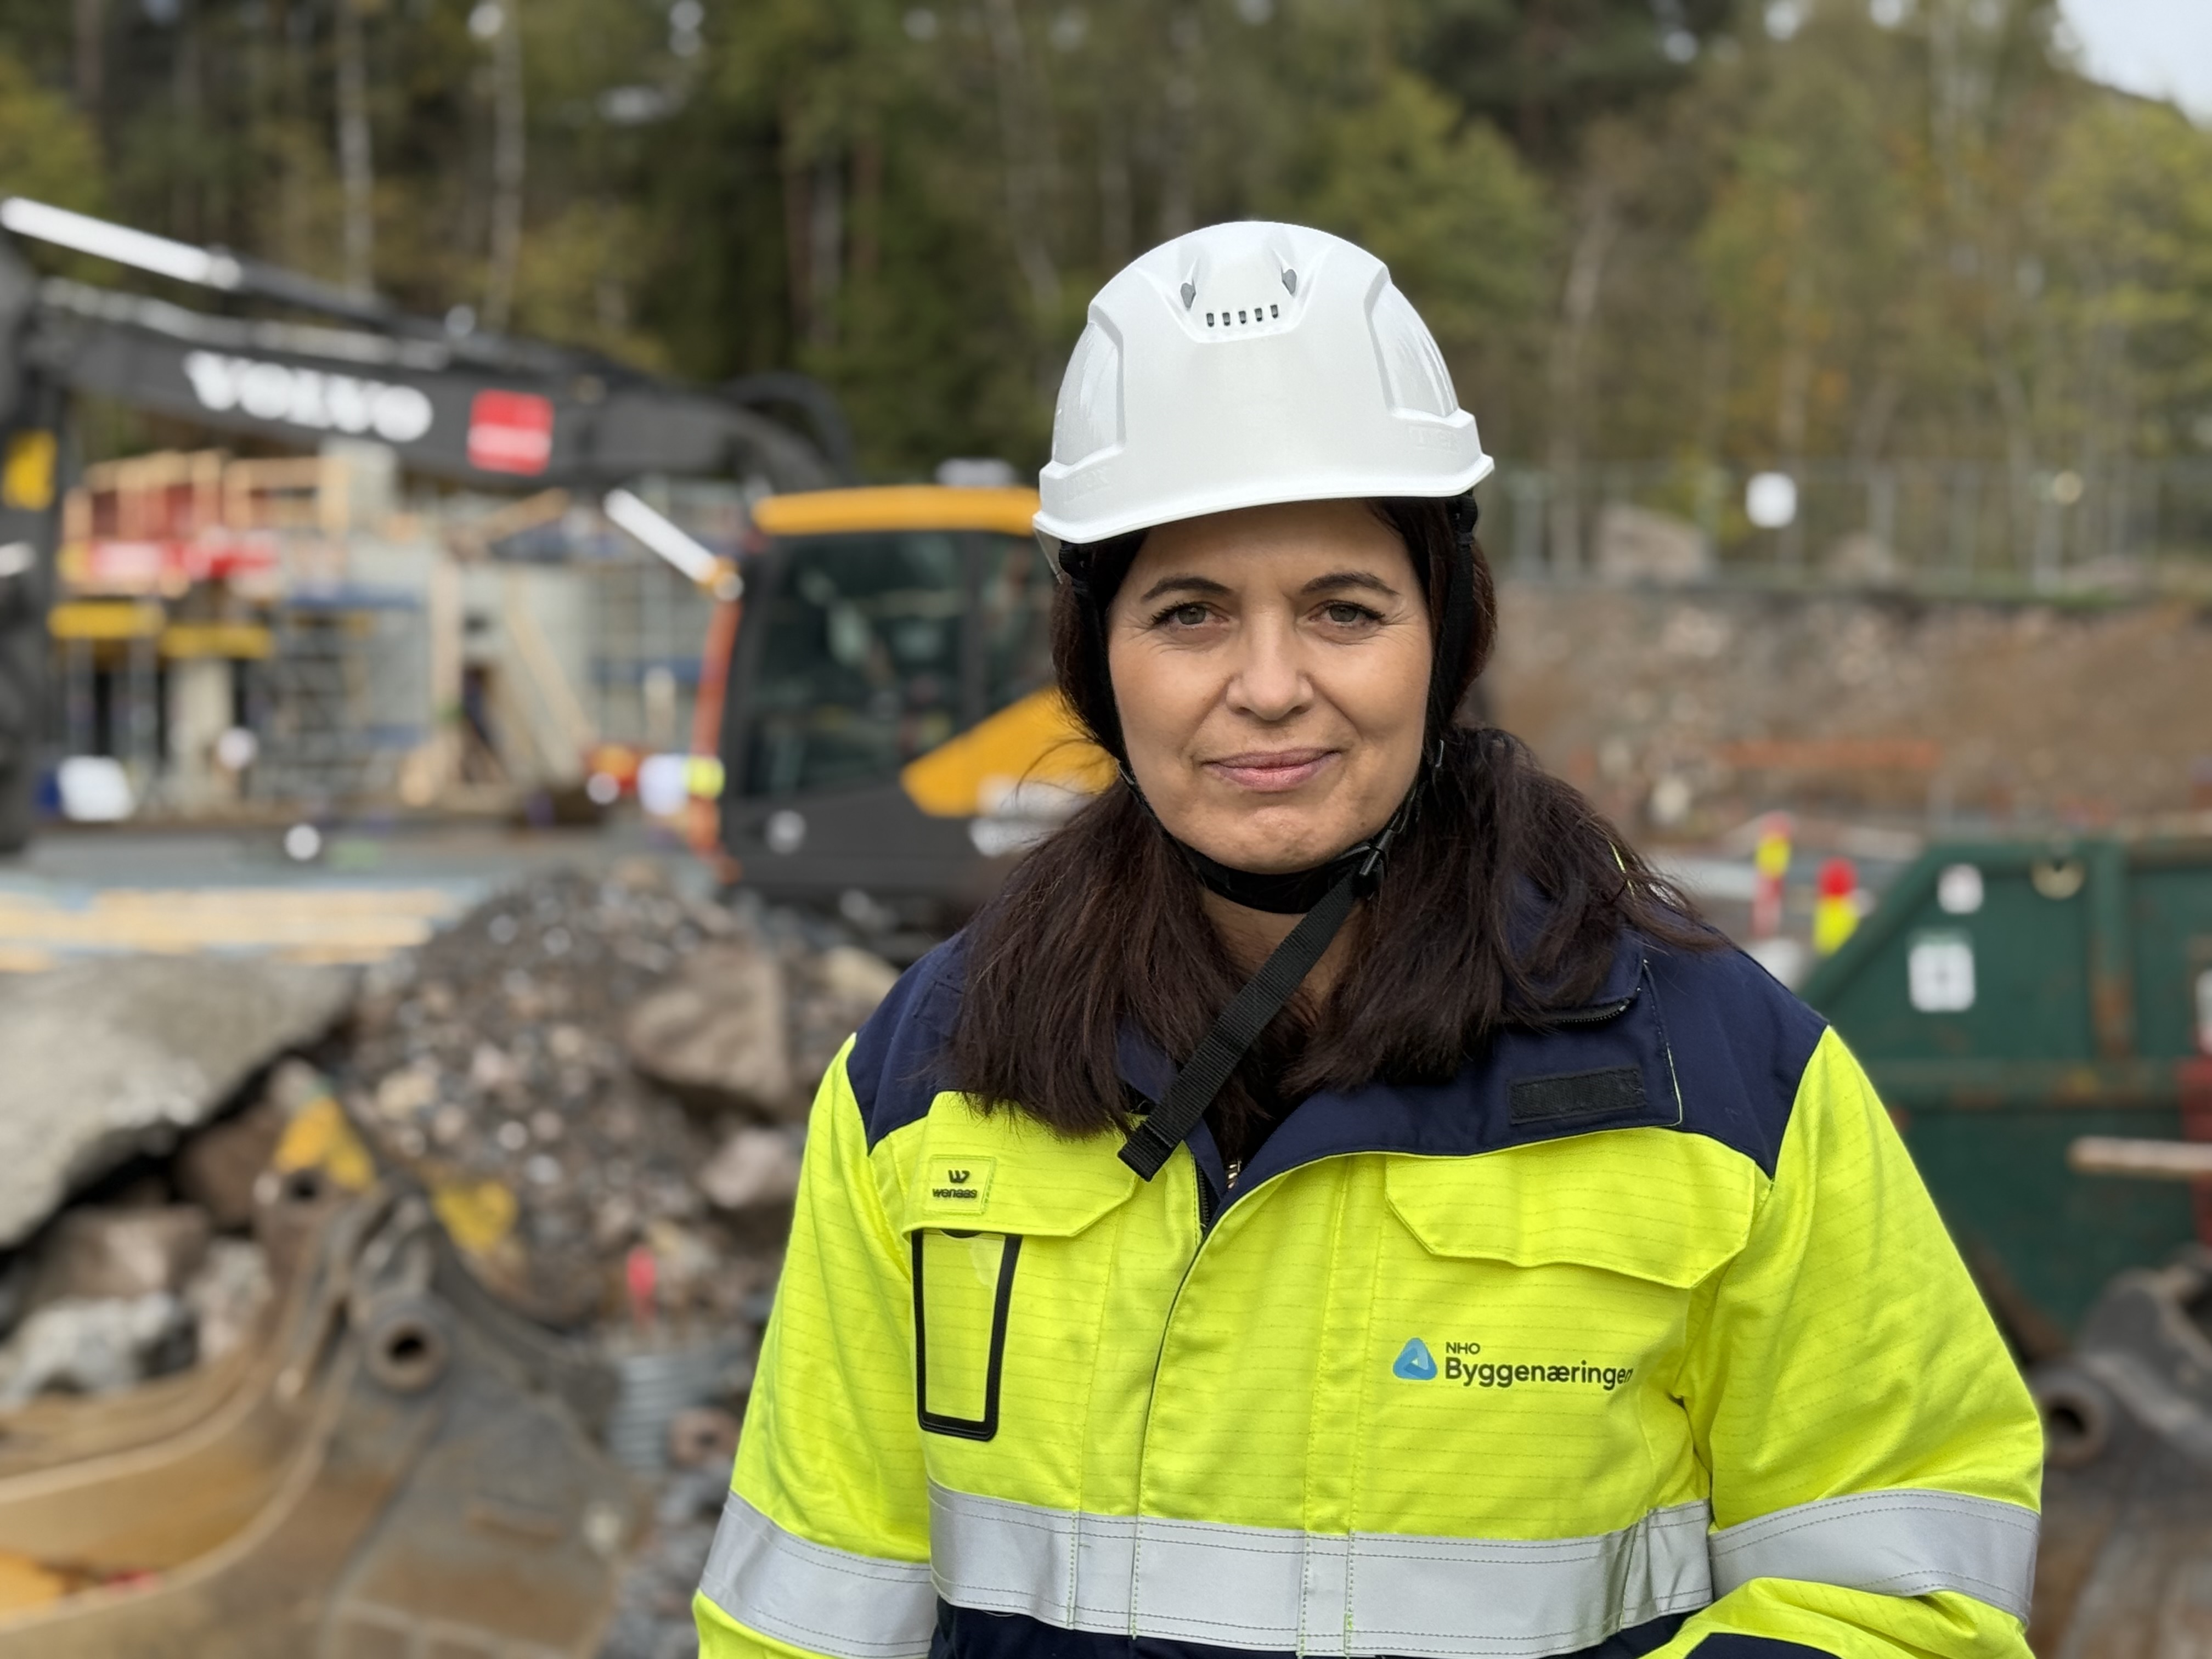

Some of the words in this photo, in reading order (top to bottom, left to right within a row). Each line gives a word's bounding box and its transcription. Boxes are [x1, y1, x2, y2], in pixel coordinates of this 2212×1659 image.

[933, 1189, 977, 1198] wenaas
[1446, 1342, 1480, 1355] NHO
[1446, 1357, 1633, 1391] Byggenæringen
